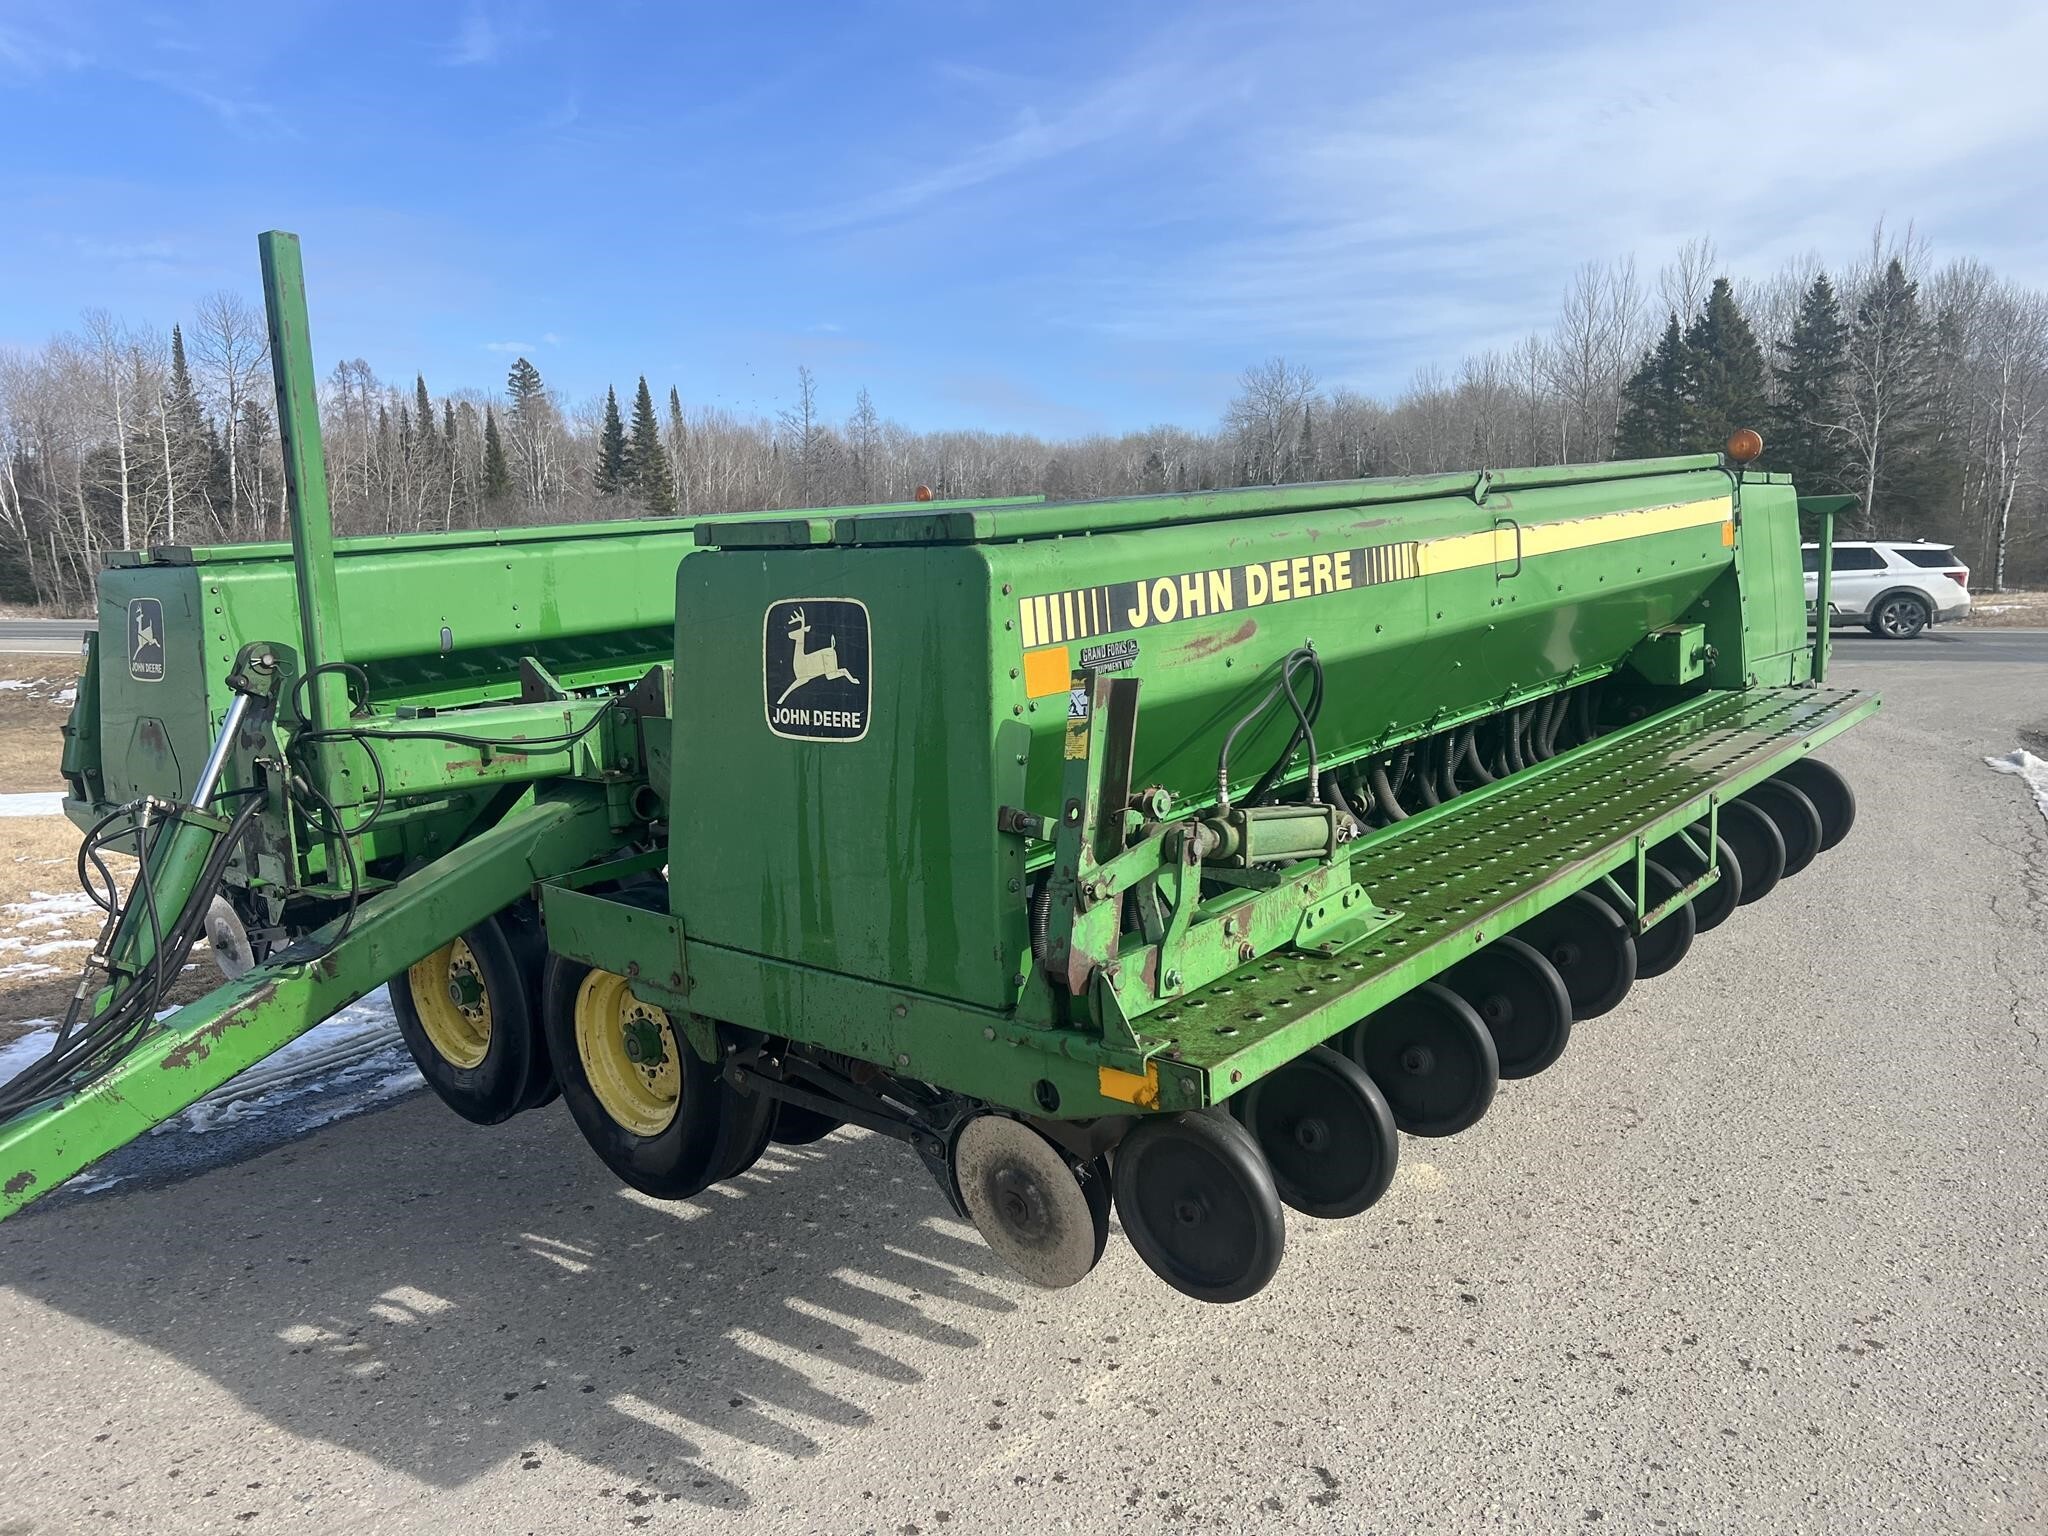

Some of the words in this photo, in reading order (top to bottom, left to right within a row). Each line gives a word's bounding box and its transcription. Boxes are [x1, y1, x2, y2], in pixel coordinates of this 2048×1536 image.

[1128, 569, 1233, 628] JOHN
[1245, 551, 1352, 607] DEERE
[1083, 645, 1106, 662] GRAND
[1107, 640, 1127, 657] FORKS
[132, 662, 145, 672] JOHN
[146, 663, 162, 673] DEERE
[1093, 661, 1123, 674] UIPMENT
[773, 708, 810, 725] JOHN
[813, 710, 861, 728] DEERE
